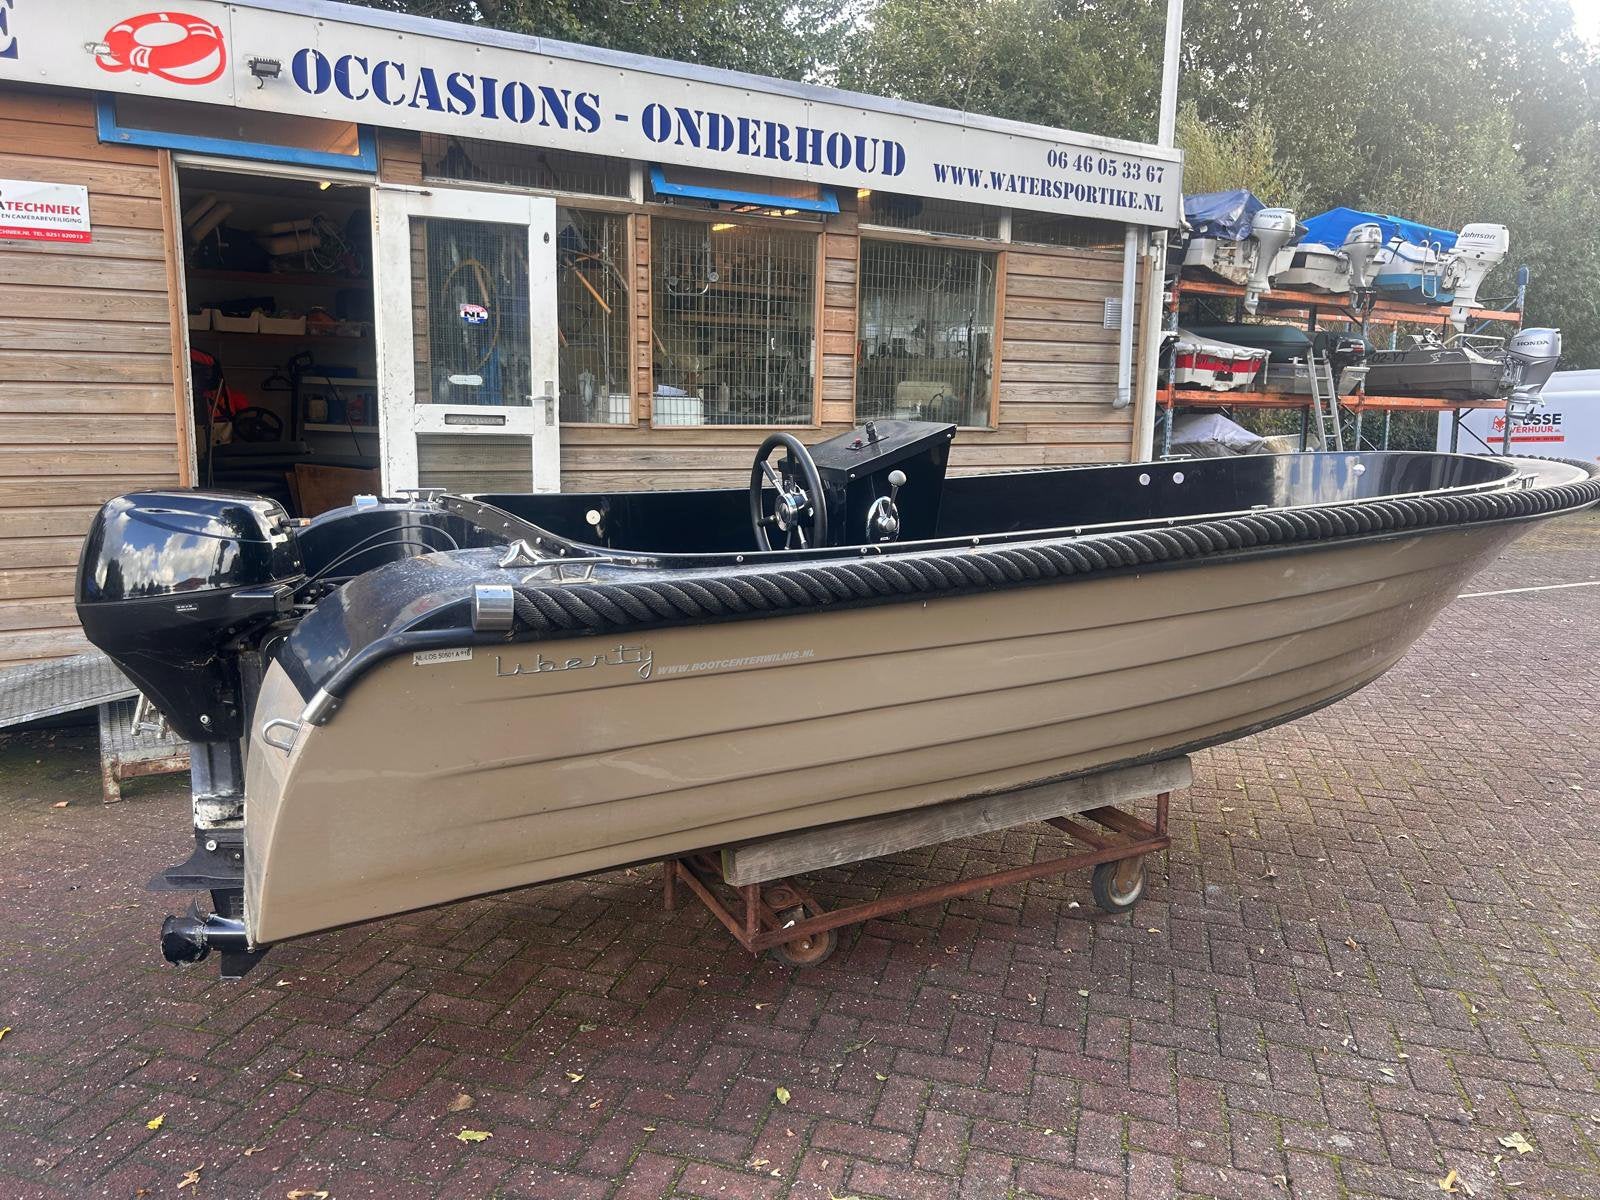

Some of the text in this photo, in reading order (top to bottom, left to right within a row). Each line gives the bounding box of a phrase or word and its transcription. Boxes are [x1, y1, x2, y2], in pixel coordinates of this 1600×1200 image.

[292, 48, 601, 134] OCCASIONS
[641, 103, 906, 177] ONDERHOUD
[1047, 149, 1165, 184] 06 46 05 33 67
[933, 163, 1164, 213] WWW.WATERSPORTIKE.NL
[495, 644, 654, 680] Liberty
[657, 649, 816, 675] WWW.BOOTCENTERWILNIS.NL
